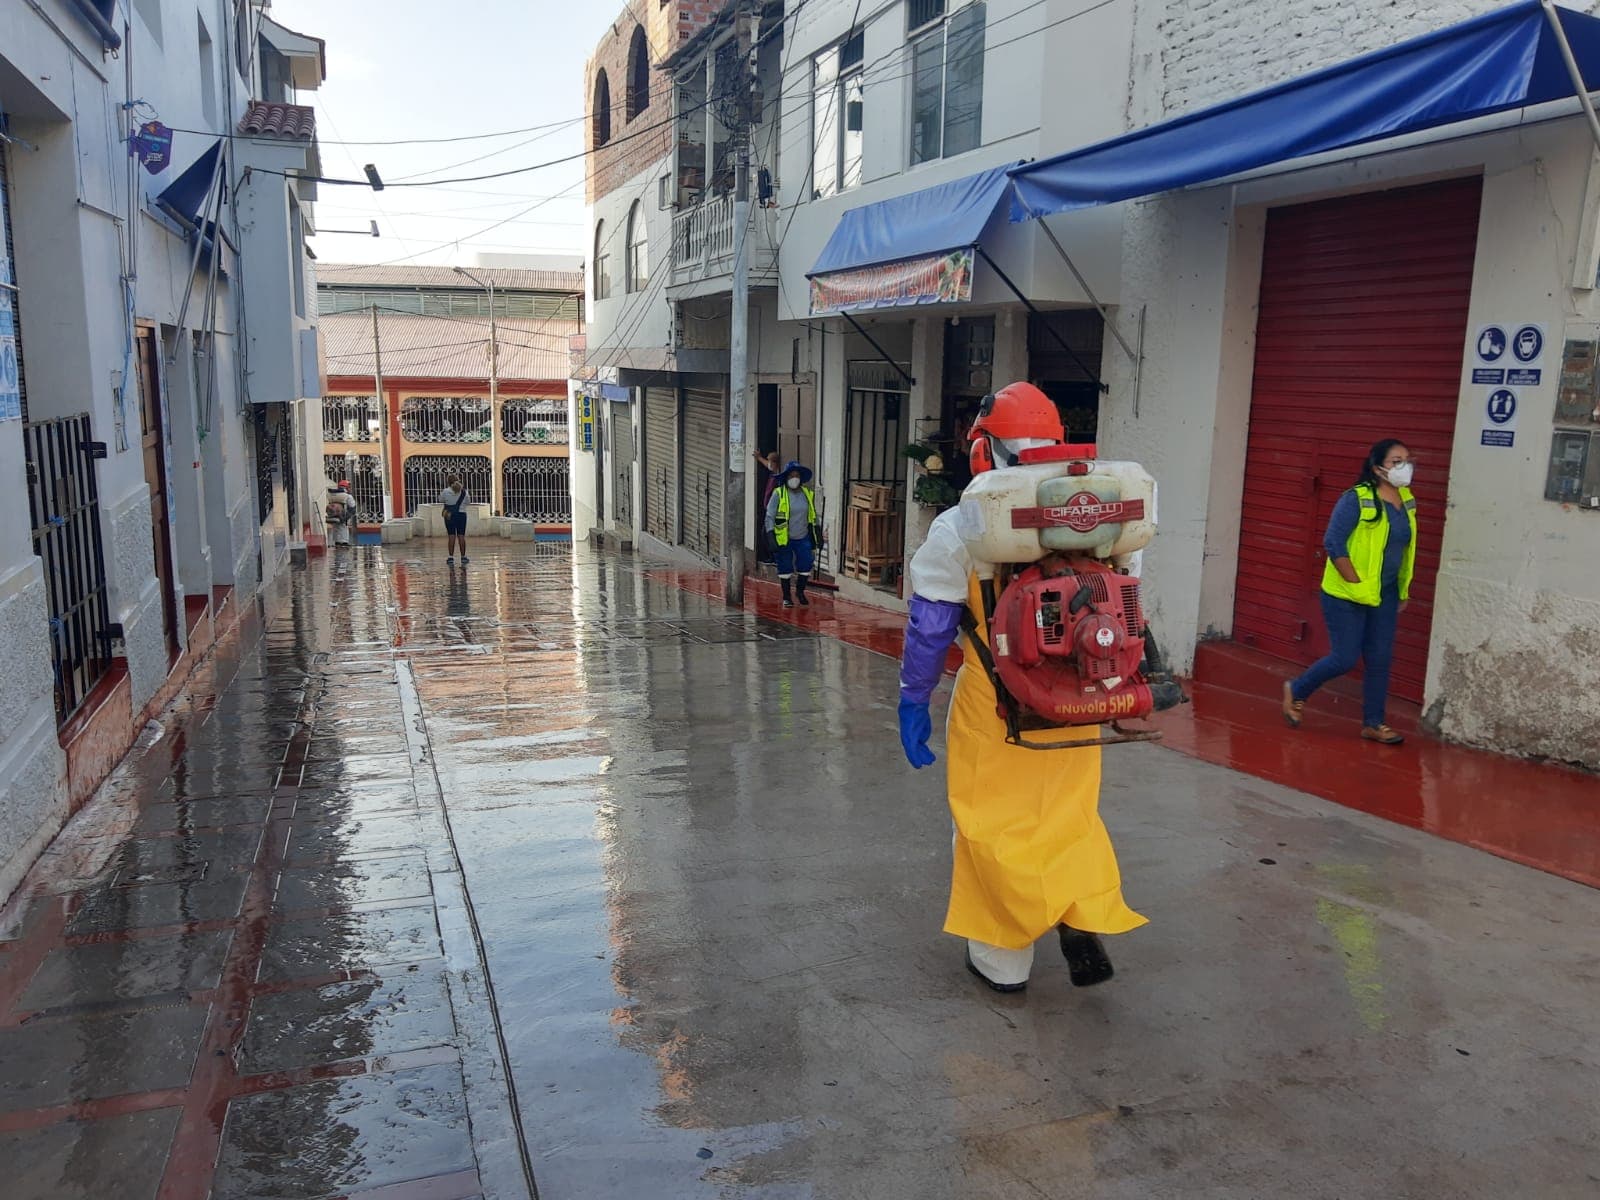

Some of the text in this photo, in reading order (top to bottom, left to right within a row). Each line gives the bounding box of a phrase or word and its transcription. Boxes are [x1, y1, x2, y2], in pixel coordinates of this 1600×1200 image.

[1051, 503, 1117, 517] CIFARELLI
[1061, 693, 1135, 714] Nuvola 5HP
